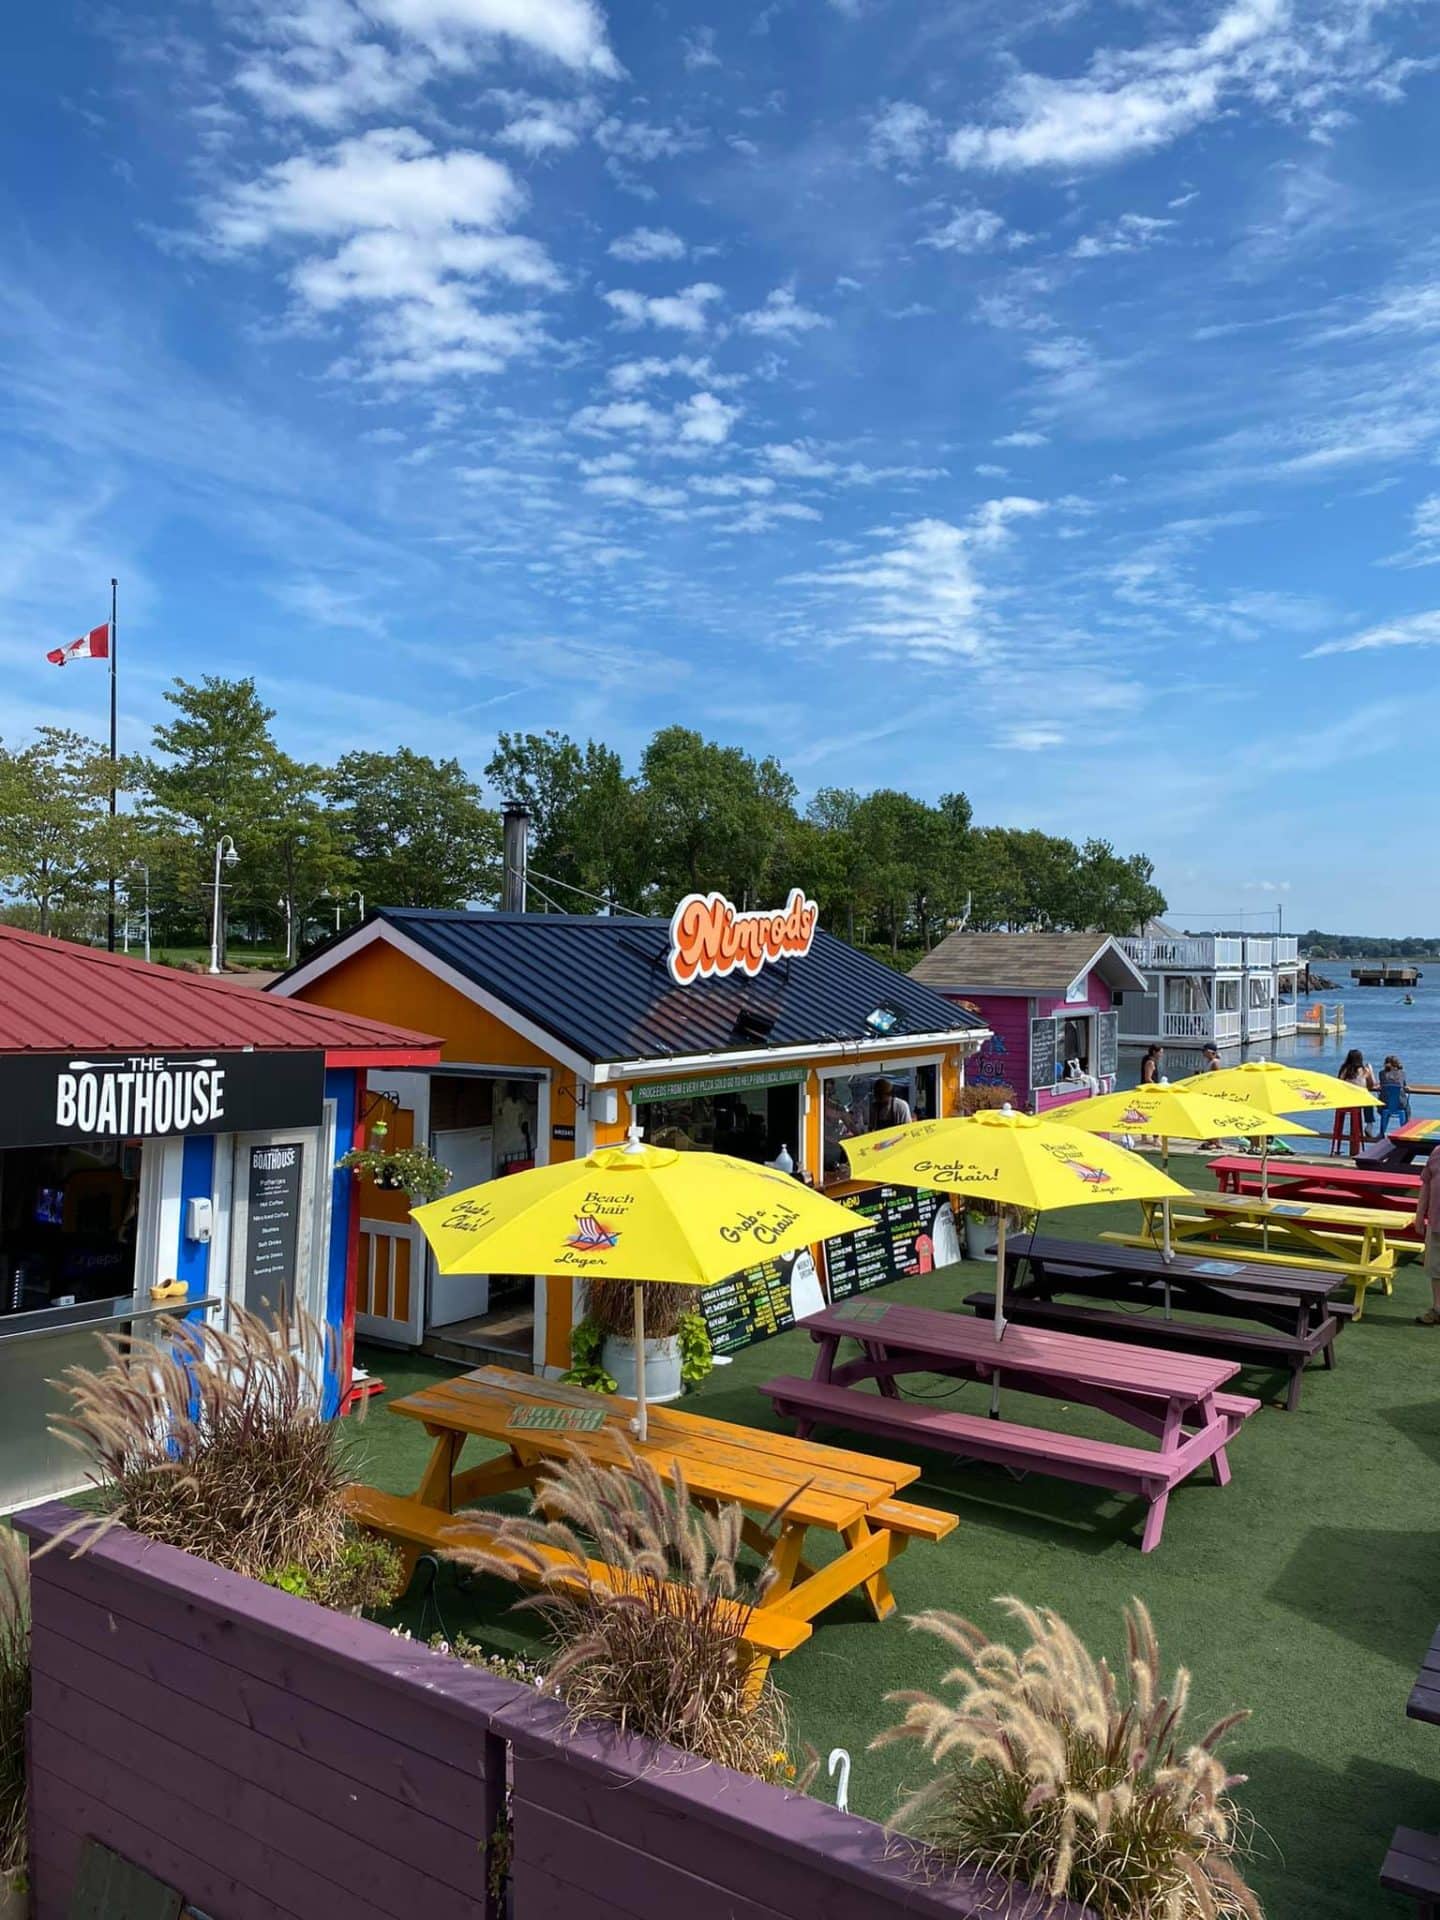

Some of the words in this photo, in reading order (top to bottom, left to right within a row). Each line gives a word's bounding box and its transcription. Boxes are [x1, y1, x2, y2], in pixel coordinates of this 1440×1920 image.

[127, 1057, 165, 1072] THE
[56, 1070, 225, 1136] BOATHOUSE
[253, 1150, 296, 1170] BOATHOUSE
[913, 1160, 964, 1172] Grab
[932, 1167, 1000, 1183] Chair!
[583, 1191, 635, 1204] Beach
[451, 1200, 491, 1214] Grab
[580, 1202, 630, 1215] Chair
[441, 1214, 496, 1232] Chair!
[719, 1212, 758, 1244] Grab
[753, 1203, 801, 1245] Chair!
[553, 1252, 608, 1268] Lager
